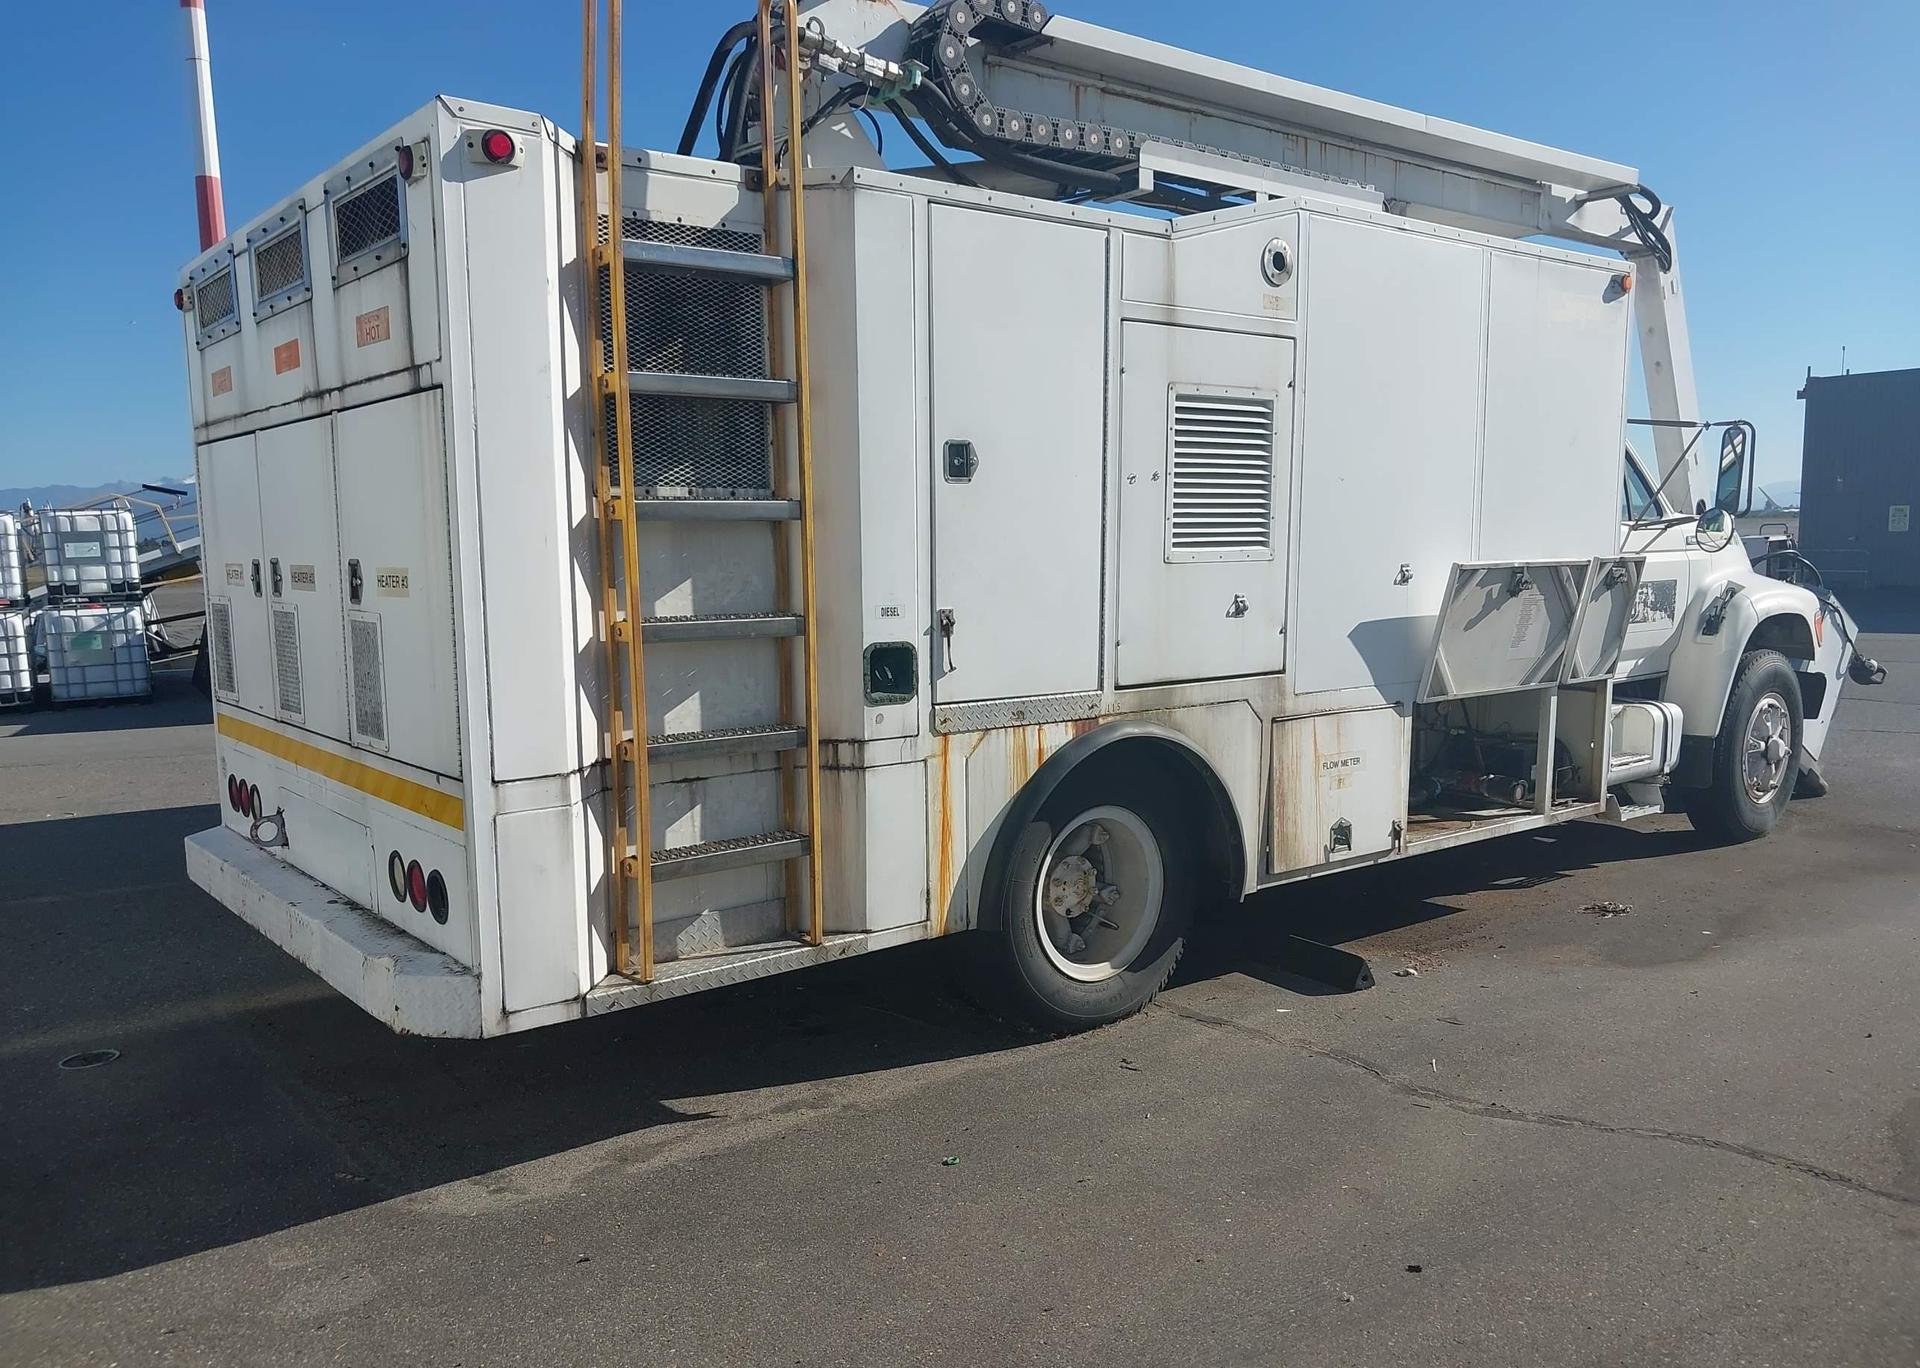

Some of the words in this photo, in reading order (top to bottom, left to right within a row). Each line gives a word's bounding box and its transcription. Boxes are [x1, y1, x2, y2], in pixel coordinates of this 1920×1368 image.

[365, 324, 381, 341] HOT
[377, 575, 400, 588] HEATER
[401, 575, 409, 589] #3
[880, 606, 900, 617] DIESEL
[1322, 760, 1339, 770] FLOW
[1340, 757, 1361, 768] METER
